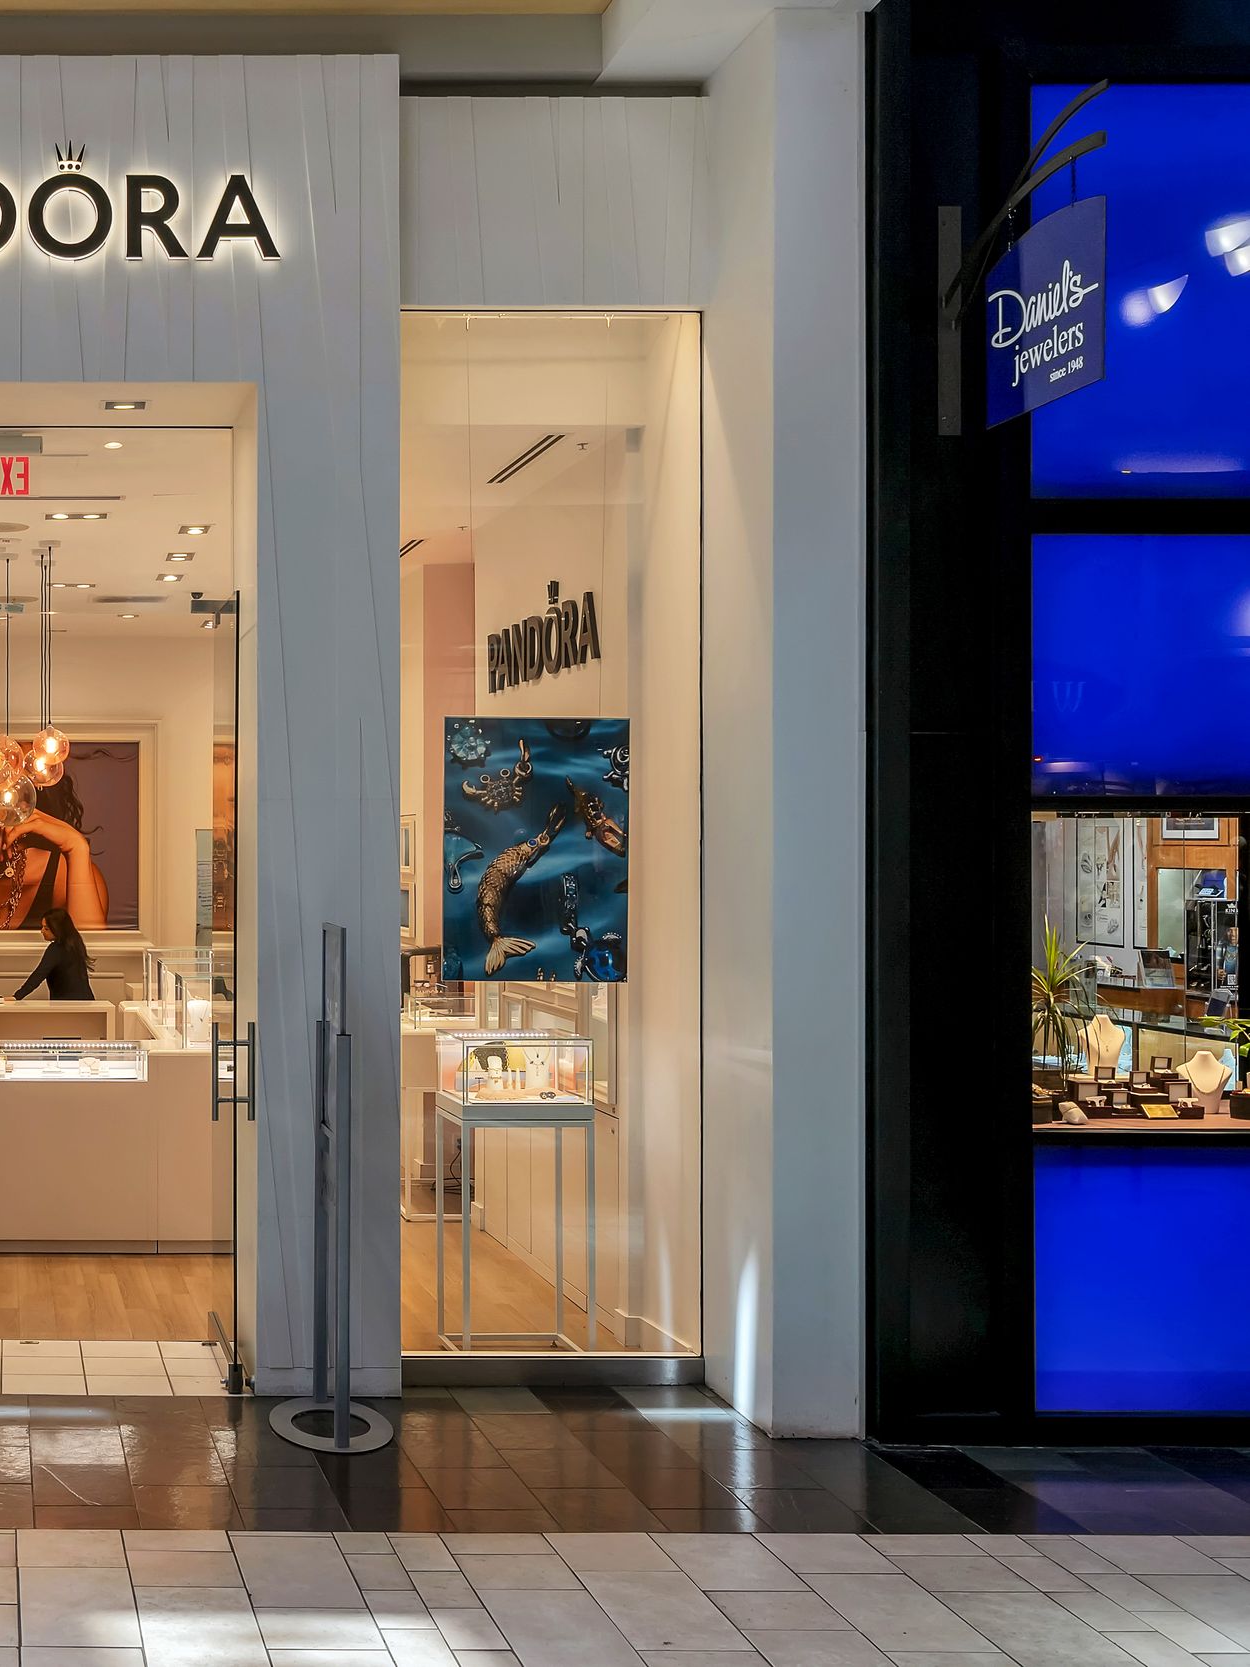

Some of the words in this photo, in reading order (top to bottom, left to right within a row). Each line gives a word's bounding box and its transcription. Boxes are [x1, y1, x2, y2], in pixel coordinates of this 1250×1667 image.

[987, 259, 1099, 348] Daniel's
[1011, 321, 1084, 387] jewelers
[1049, 365, 1067, 382] since
[1067, 356, 1084, 373] 1948
[487, 590, 602, 694] PANDORA
